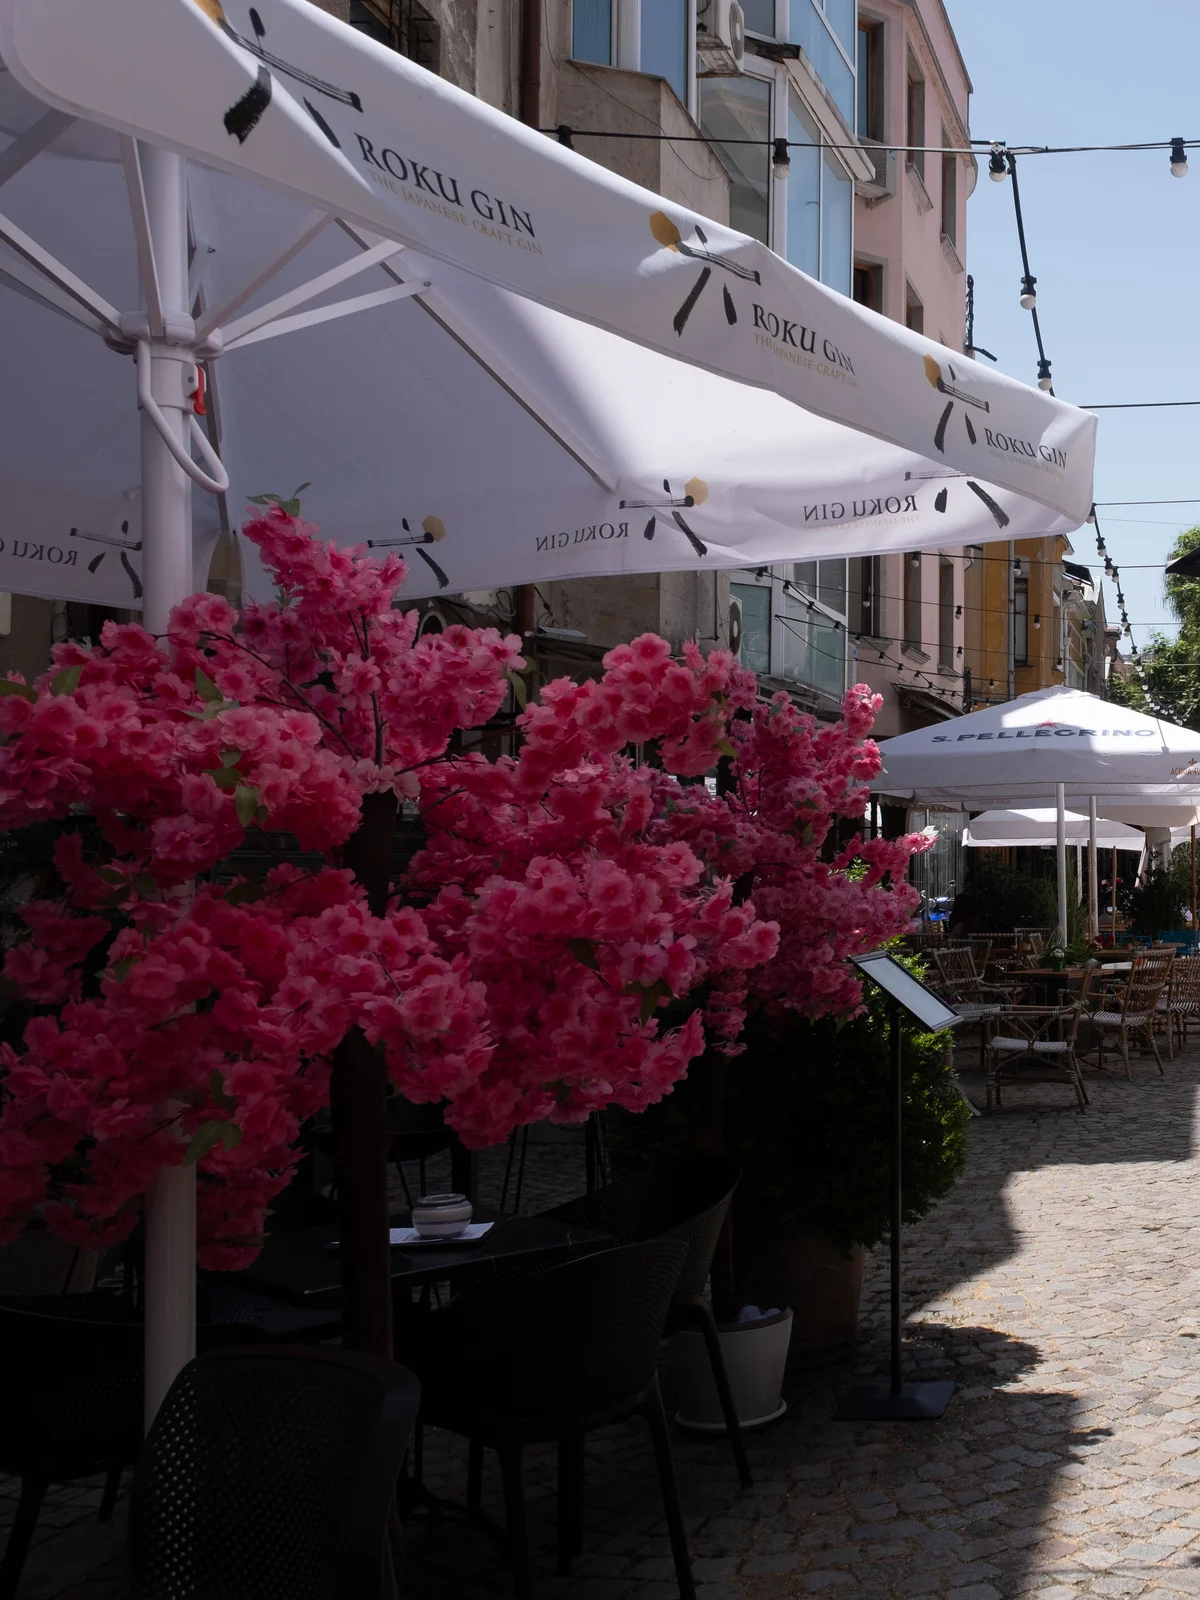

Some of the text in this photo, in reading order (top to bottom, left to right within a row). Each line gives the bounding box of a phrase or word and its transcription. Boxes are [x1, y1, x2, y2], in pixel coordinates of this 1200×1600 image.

[353, 131, 536, 239] ROKU GIN
[368, 169, 543, 255] THE JAPANESE CRAFT GIN
[752, 303, 856, 376] ROKU GIN
[816, 363, 846, 383] CRAFT
[984, 427, 1067, 470] ROKU GIN
